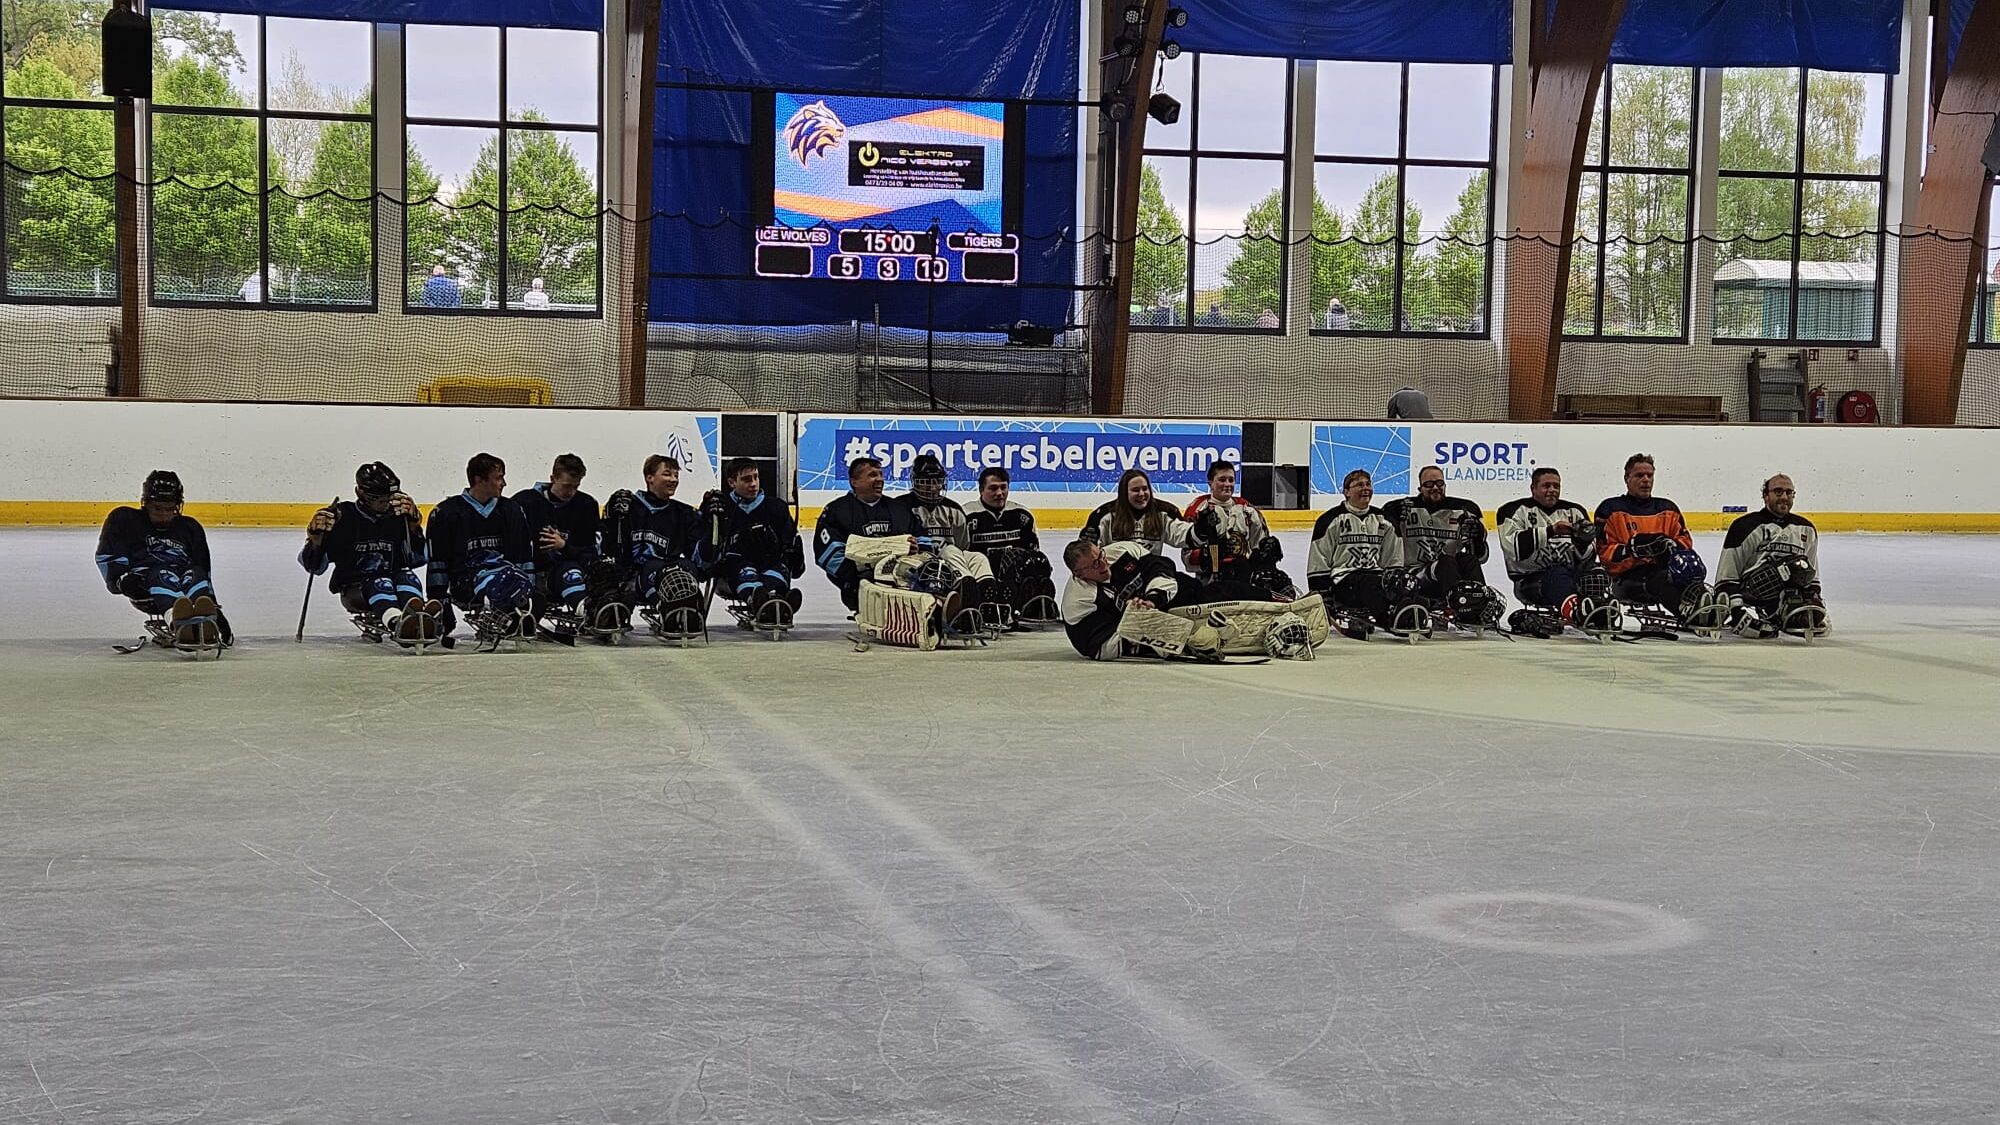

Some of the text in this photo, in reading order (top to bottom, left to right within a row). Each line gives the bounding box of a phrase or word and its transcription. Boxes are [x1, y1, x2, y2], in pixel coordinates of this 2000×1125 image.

[899, 149, 953, 158] ELEKTRO
[880, 157, 907, 165] NICO
[760, 229, 827, 242] ICE WOLVES
[964, 236, 1003, 248] TIGERS
[841, 257, 854, 276] 5
[882, 260, 894, 277] 3
[921, 260, 944, 278] 10
[1442, 467, 1534, 481] LAANDEREN
[632, 531, 643, 541] ICE
